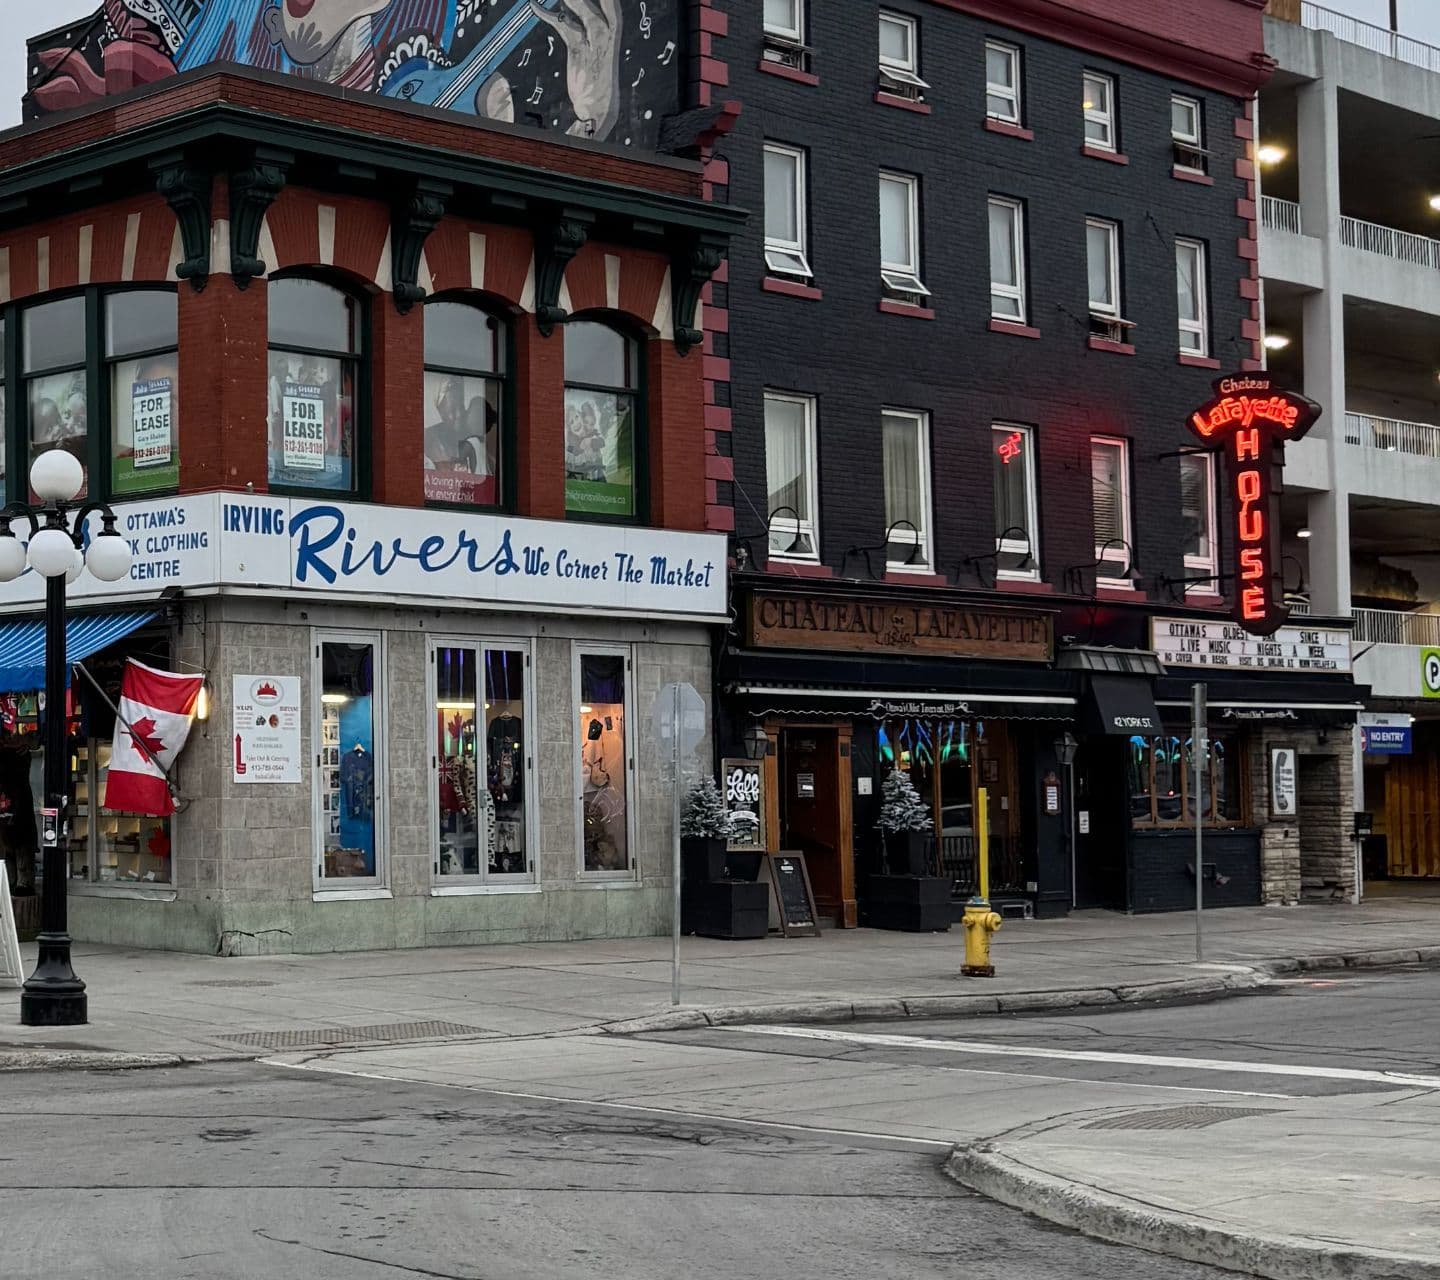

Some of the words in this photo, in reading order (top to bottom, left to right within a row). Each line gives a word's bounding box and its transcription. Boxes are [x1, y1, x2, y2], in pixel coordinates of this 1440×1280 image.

[140, 397, 164, 413] FOR
[291, 402, 316, 420] FOR
[135, 414, 170, 433] LEASE
[1193, 396, 1299, 436] Lafayette
[285, 421, 323, 439] LEASE
[127, 506, 185, 531] OTTAWA'S
[1236, 428, 1267, 620] HOUSE
[146, 531, 208, 555] CLOTHING
[223, 504, 284, 536] IRVING
[288, 505, 521, 584] Rivers
[523, 546, 550, 576] We
[556, 549, 608, 581] Corner
[614, 552, 643, 583] The
[650, 556, 714, 587] Market
[130, 559, 180, 581] CENTRE
[1169, 623, 1207, 638] OTTAWAS
[1300, 631, 1320, 644] SINCE
[1180, 639, 1200, 653] LIVE
[1208, 640, 1231, 654] MUSIC
[1257, 643, 1282, 657] NIGHTS
[1308, 646, 1325, 659] WEEK
[1430, 661, 1439, 684] P
[1371, 731, 1381, 741] NO
[1382, 731, 1405, 742] ENTRY
